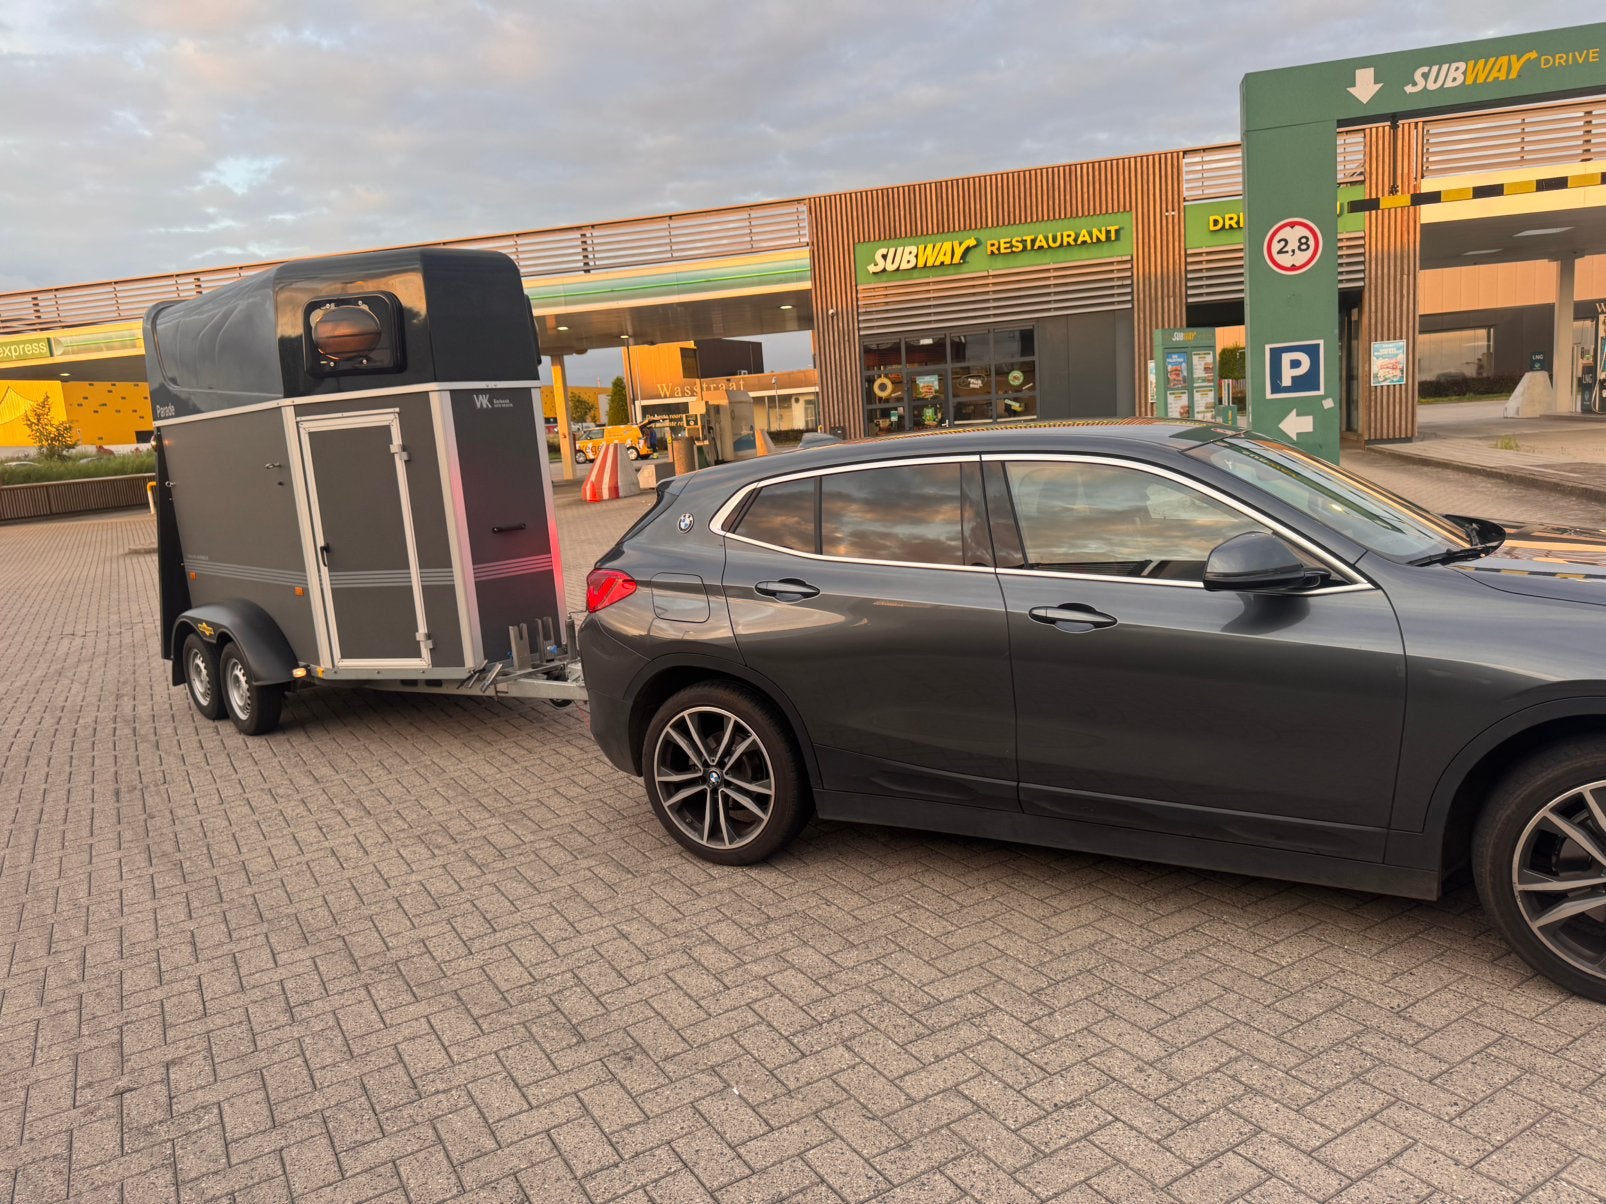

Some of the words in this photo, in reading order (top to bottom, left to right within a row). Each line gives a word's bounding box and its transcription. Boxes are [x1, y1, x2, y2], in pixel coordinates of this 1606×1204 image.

[1403, 50, 1538, 94] SUBWAY
[1540, 48, 1600, 69] DRIVE
[867, 236, 977, 274] SUBWAY
[987, 225, 1120, 255] RESTAURANT
[1276, 235, 1311, 256] 2,8
[1281, 351, 1311, 387] P
[657, 378, 745, 398] Wasstraat
